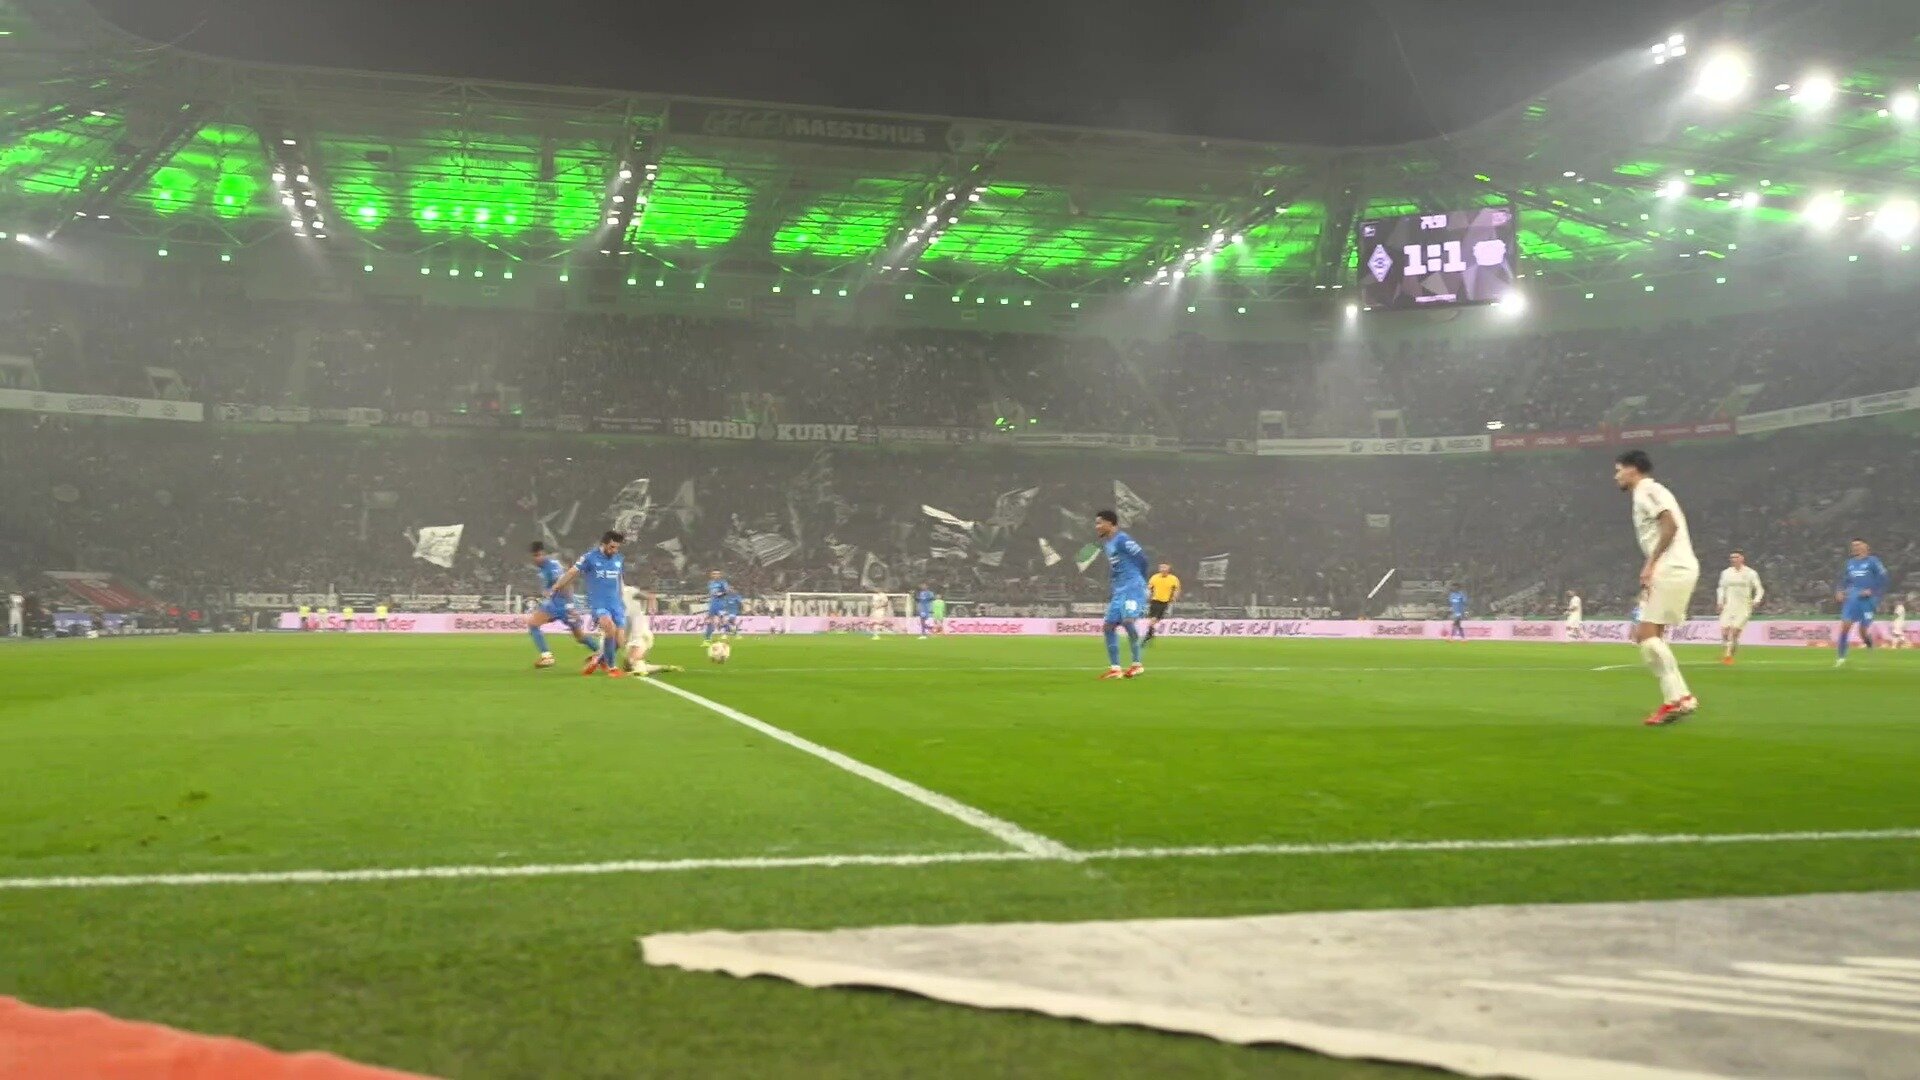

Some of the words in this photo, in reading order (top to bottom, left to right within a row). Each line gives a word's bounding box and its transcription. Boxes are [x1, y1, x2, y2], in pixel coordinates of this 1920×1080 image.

[794, 116, 927, 144] RASSISMUS
[1403, 241, 1467, 276] 1:1
[689, 420, 756, 440] NORD
[776, 423, 859, 442] KURVE
[948, 620, 1023, 634] Santander
